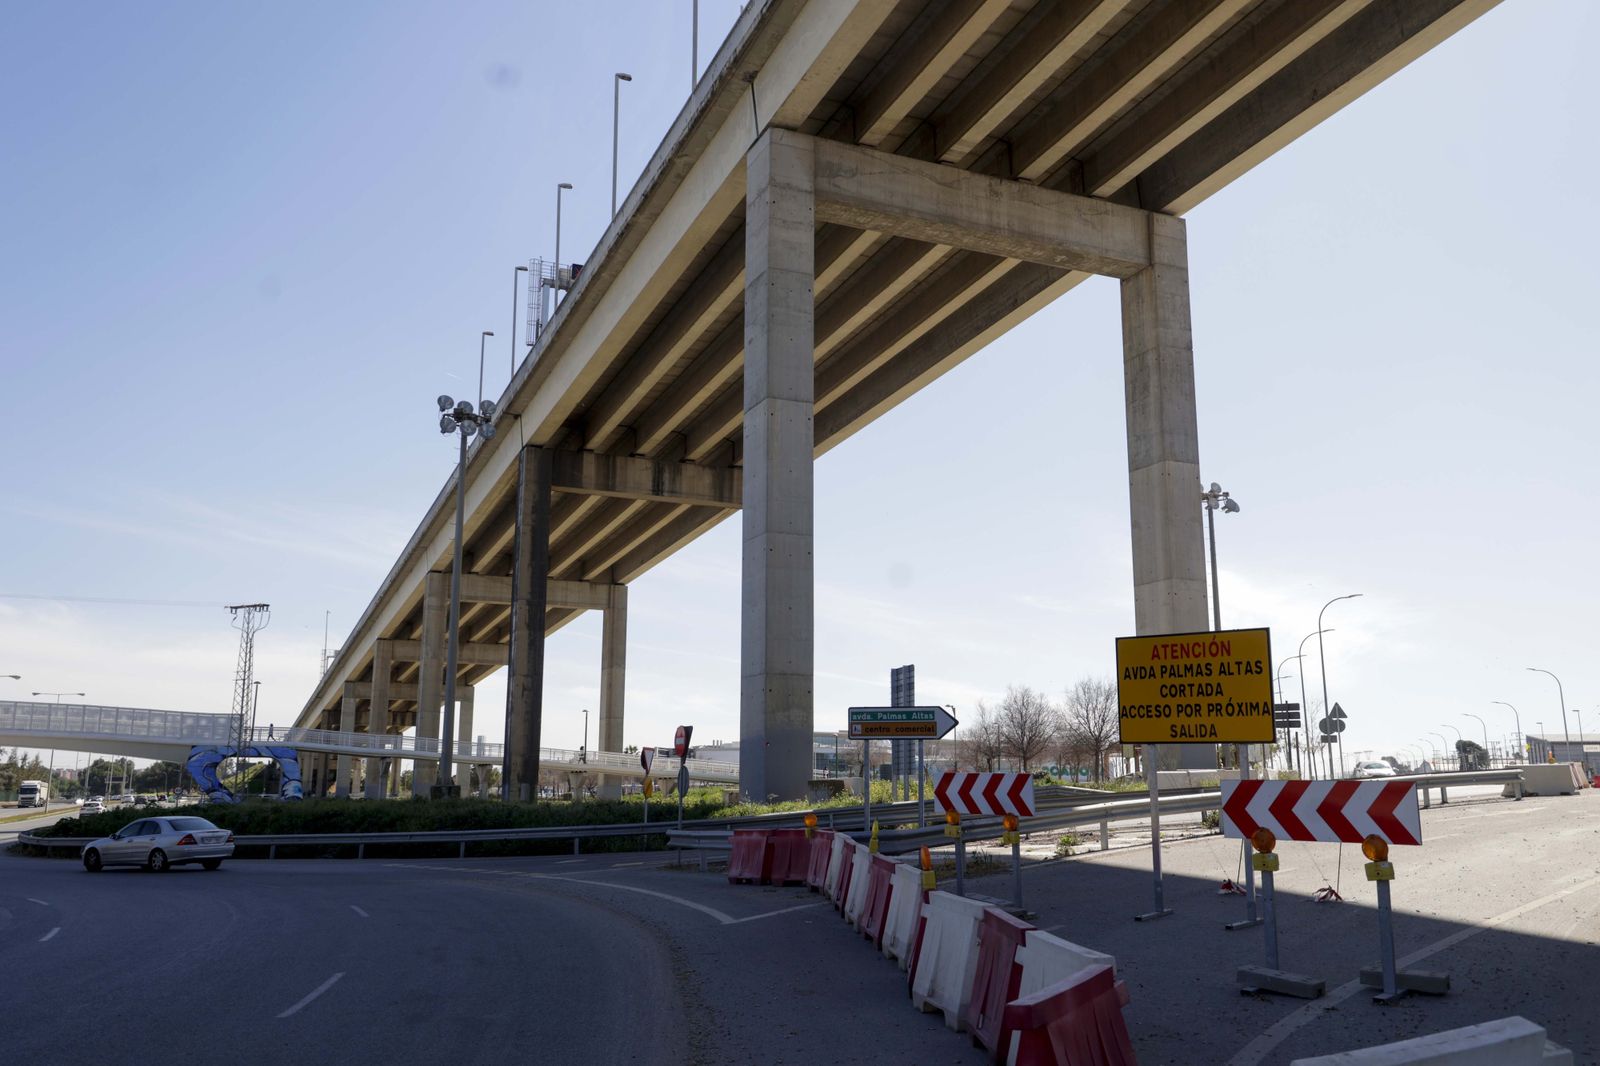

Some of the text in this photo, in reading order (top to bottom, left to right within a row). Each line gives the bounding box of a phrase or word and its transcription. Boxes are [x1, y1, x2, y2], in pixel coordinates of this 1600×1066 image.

[1151, 635, 1231, 660] ATENCIÓN
[1123, 660, 1263, 680] AVDA PALMAS ALTAS
[1160, 682, 1224, 698] CORTADA
[911, 712, 934, 720] Altas
[1121, 697, 1271, 719] ACCESO POR PRÓXIMA
[895, 724, 935, 733] comercial
[1170, 723, 1218, 738] SALIDA
